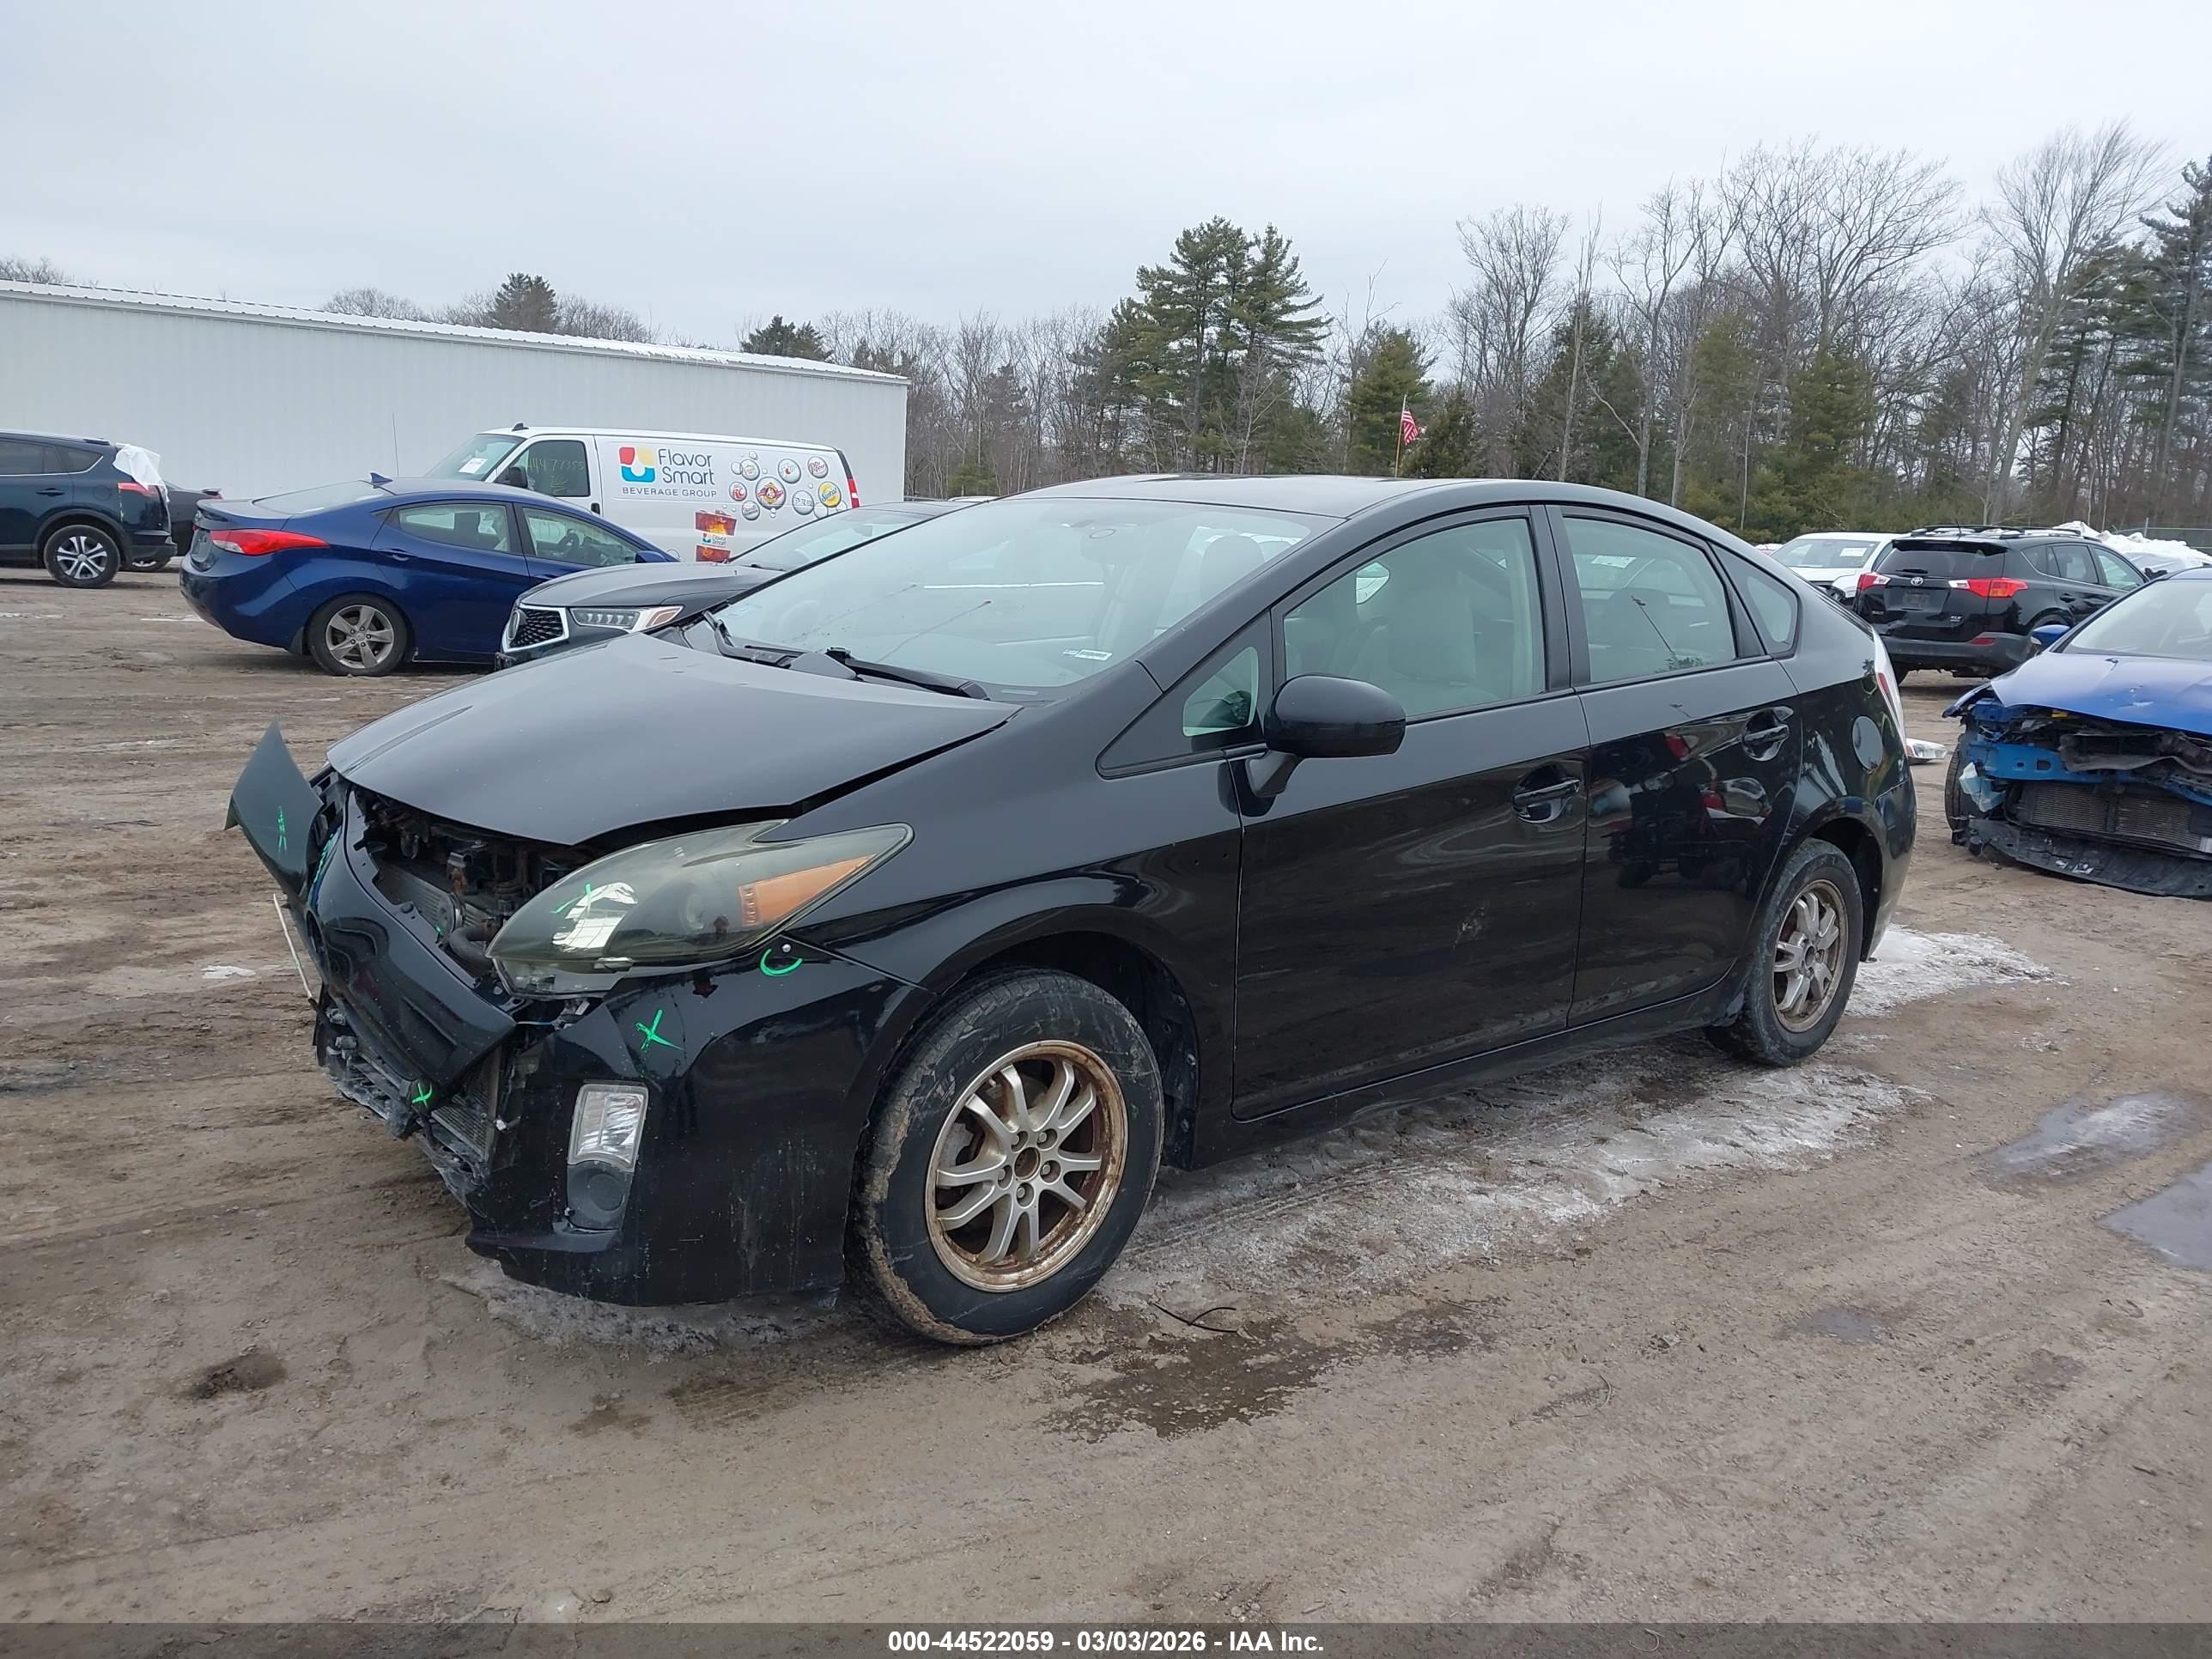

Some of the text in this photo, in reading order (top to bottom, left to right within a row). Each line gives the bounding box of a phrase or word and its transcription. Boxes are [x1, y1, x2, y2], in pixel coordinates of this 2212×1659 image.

[657, 448, 712, 468] Flavor
[661, 465, 715, 485] Smart
[622, 486, 717, 498] BEVERAGE GROUP
